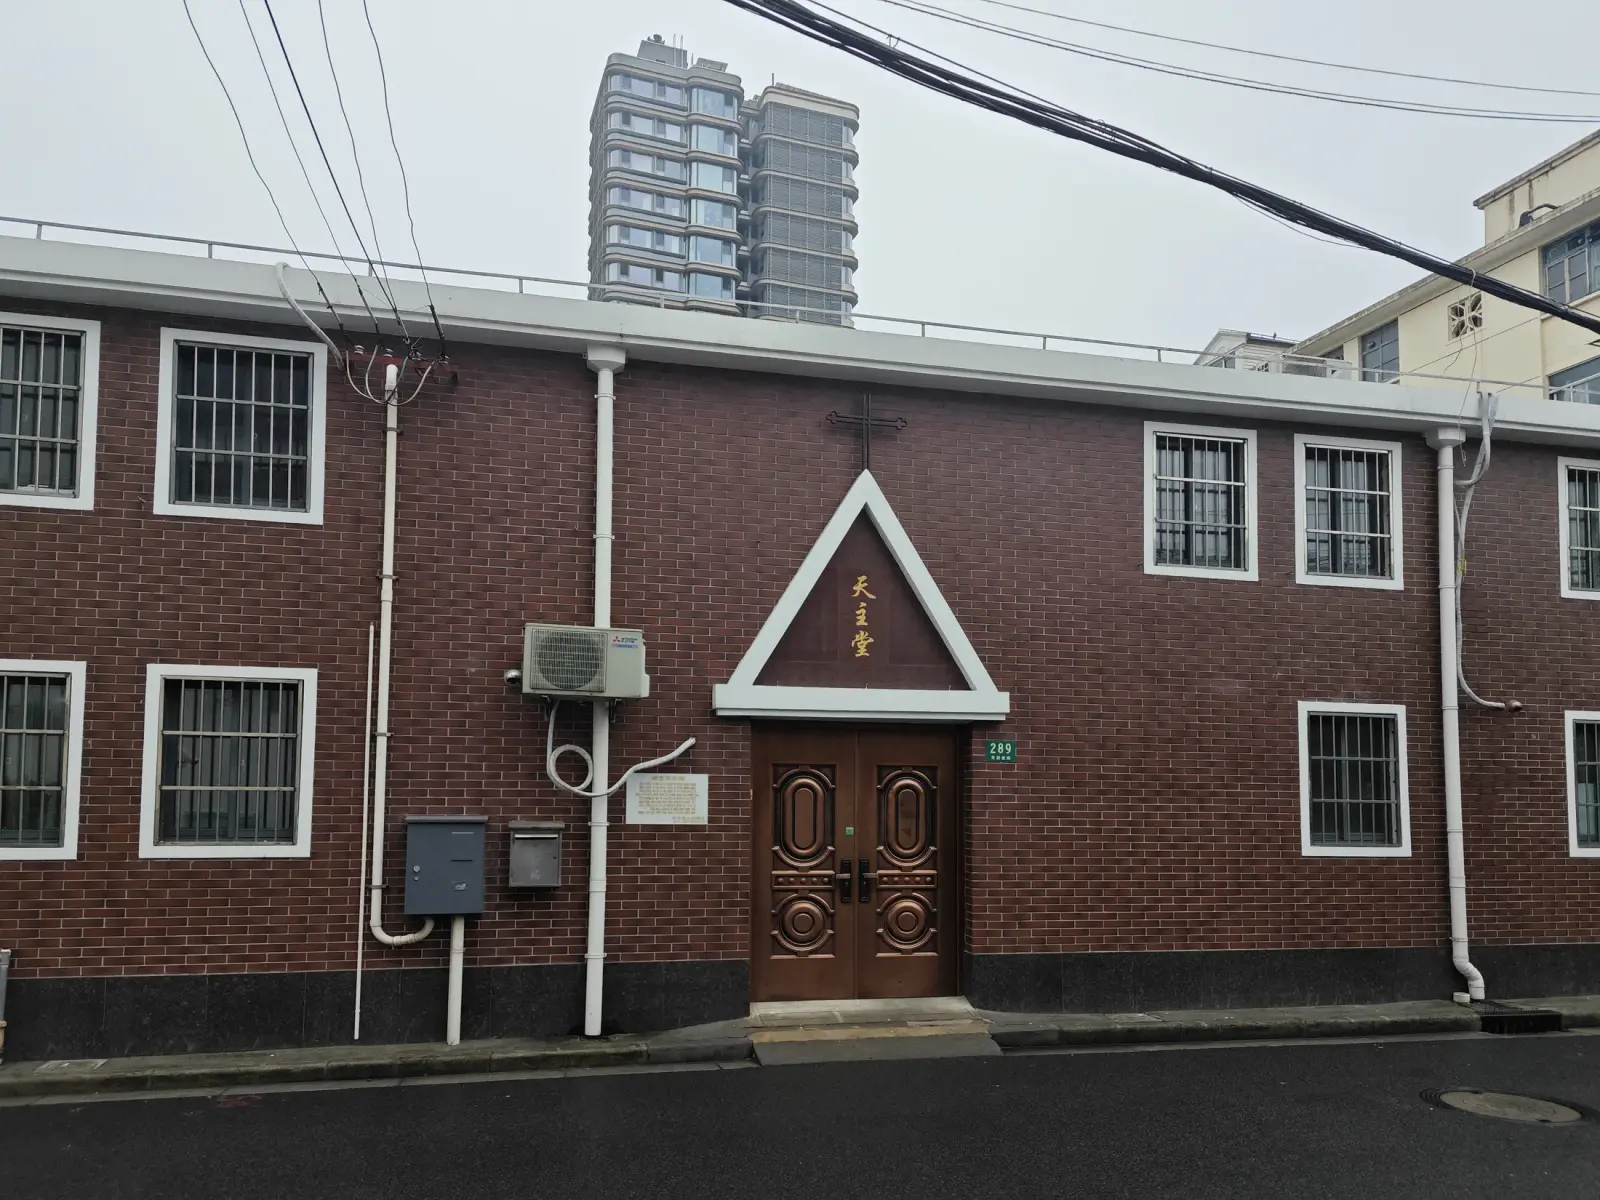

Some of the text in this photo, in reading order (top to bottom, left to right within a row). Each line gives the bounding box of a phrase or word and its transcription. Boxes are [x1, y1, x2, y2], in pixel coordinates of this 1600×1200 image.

[851, 575, 877, 657] 天主堂
[990, 742, 1012, 754] 289
